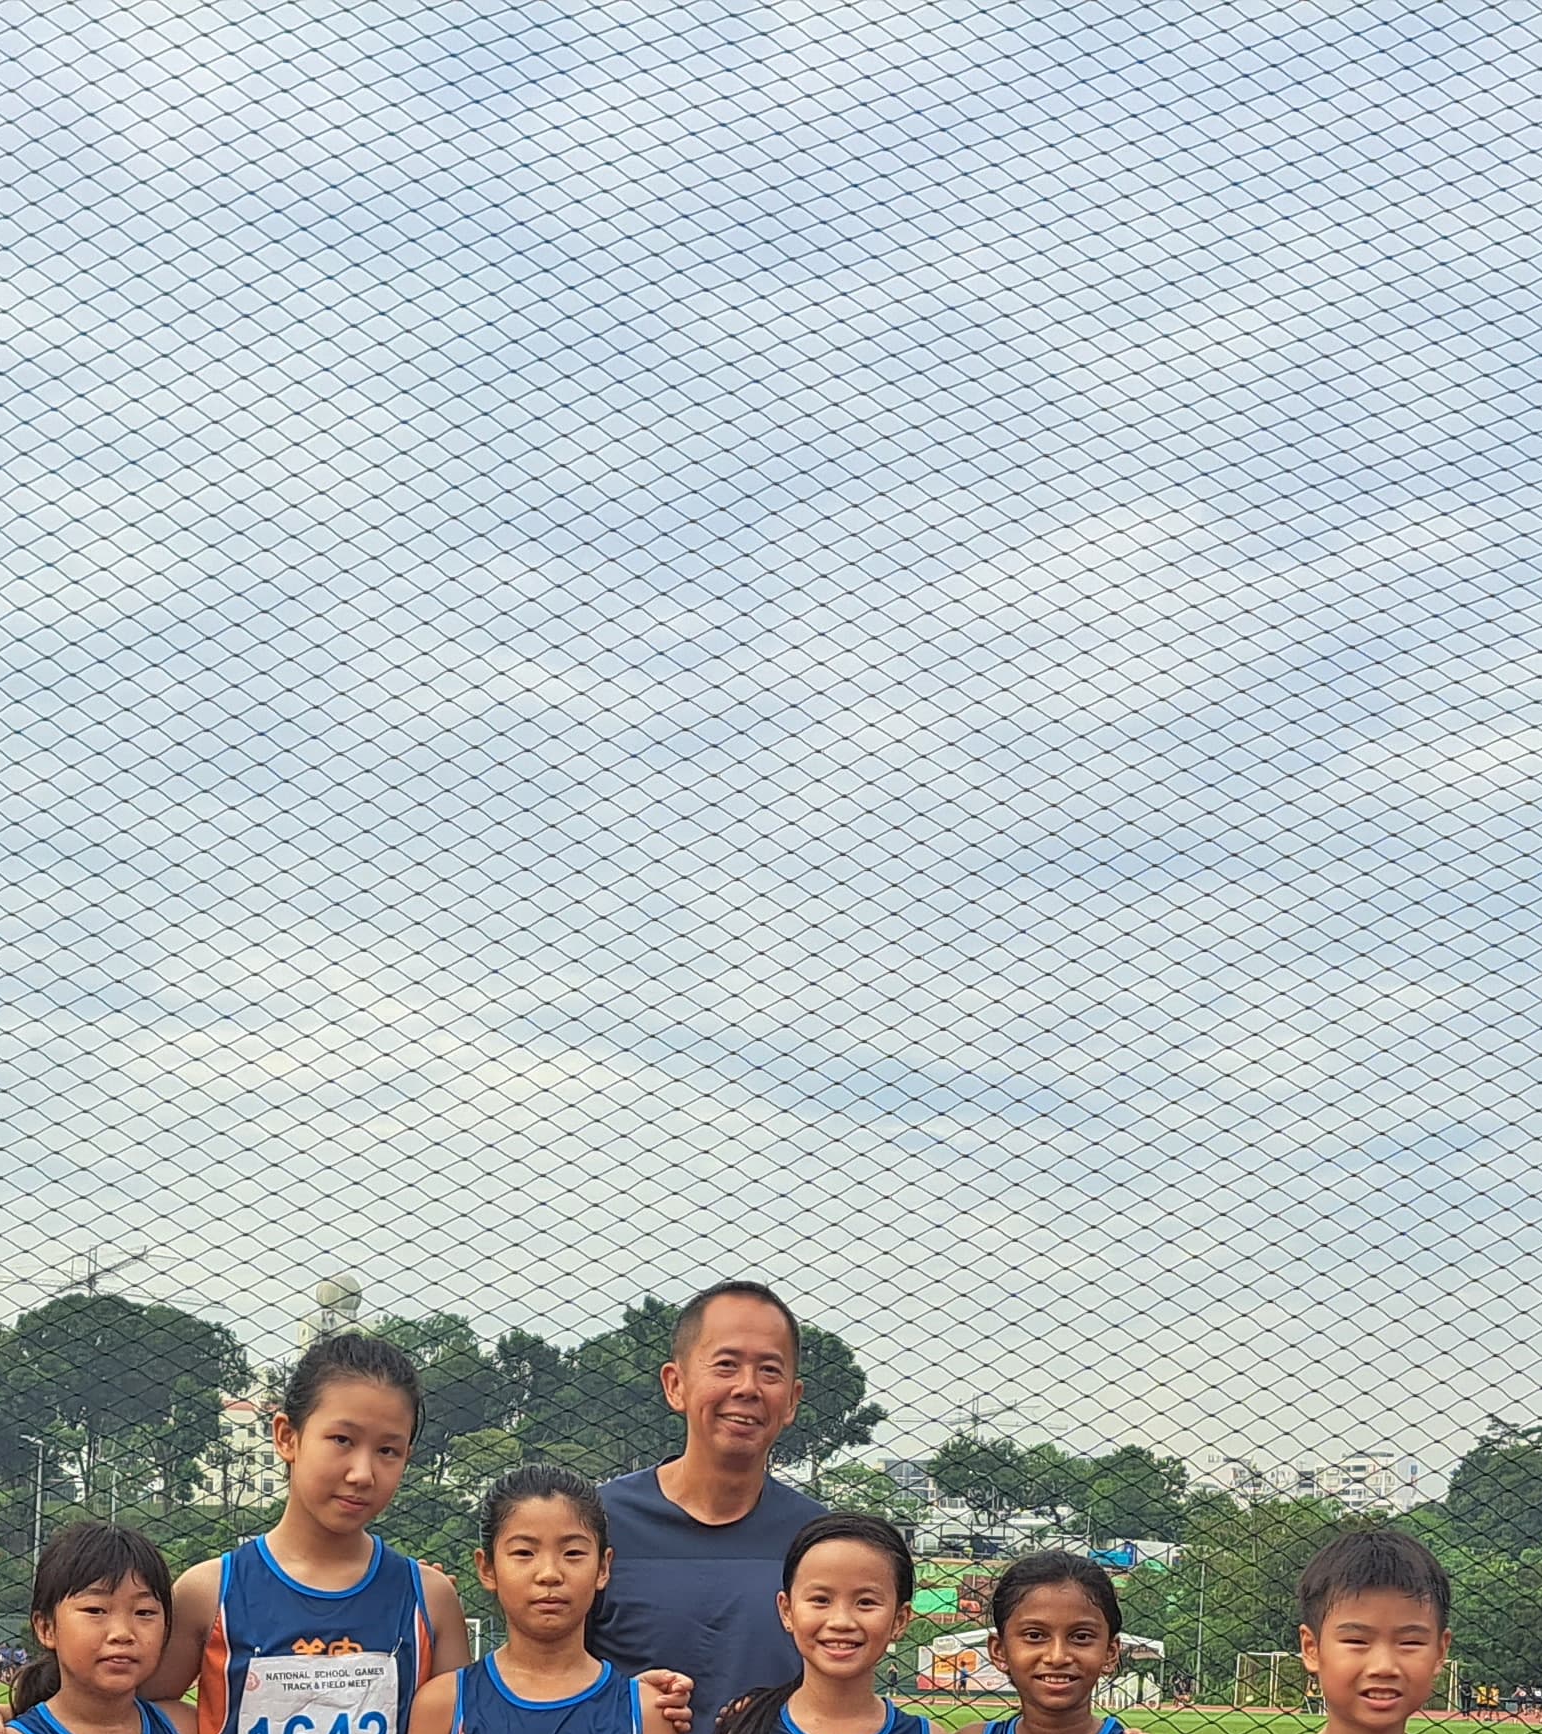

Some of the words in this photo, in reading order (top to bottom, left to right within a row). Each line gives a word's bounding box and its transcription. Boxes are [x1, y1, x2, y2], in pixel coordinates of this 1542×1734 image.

[265, 1671, 310, 1681] NATIONAL
[314, 1669, 350, 1679] SCHOOL
[354, 1667, 385, 1676] GAMES
[283, 1682, 312, 1691] TRACK
[321, 1681, 346, 1689] FIELD
[347, 1679, 372, 1688] MEET
